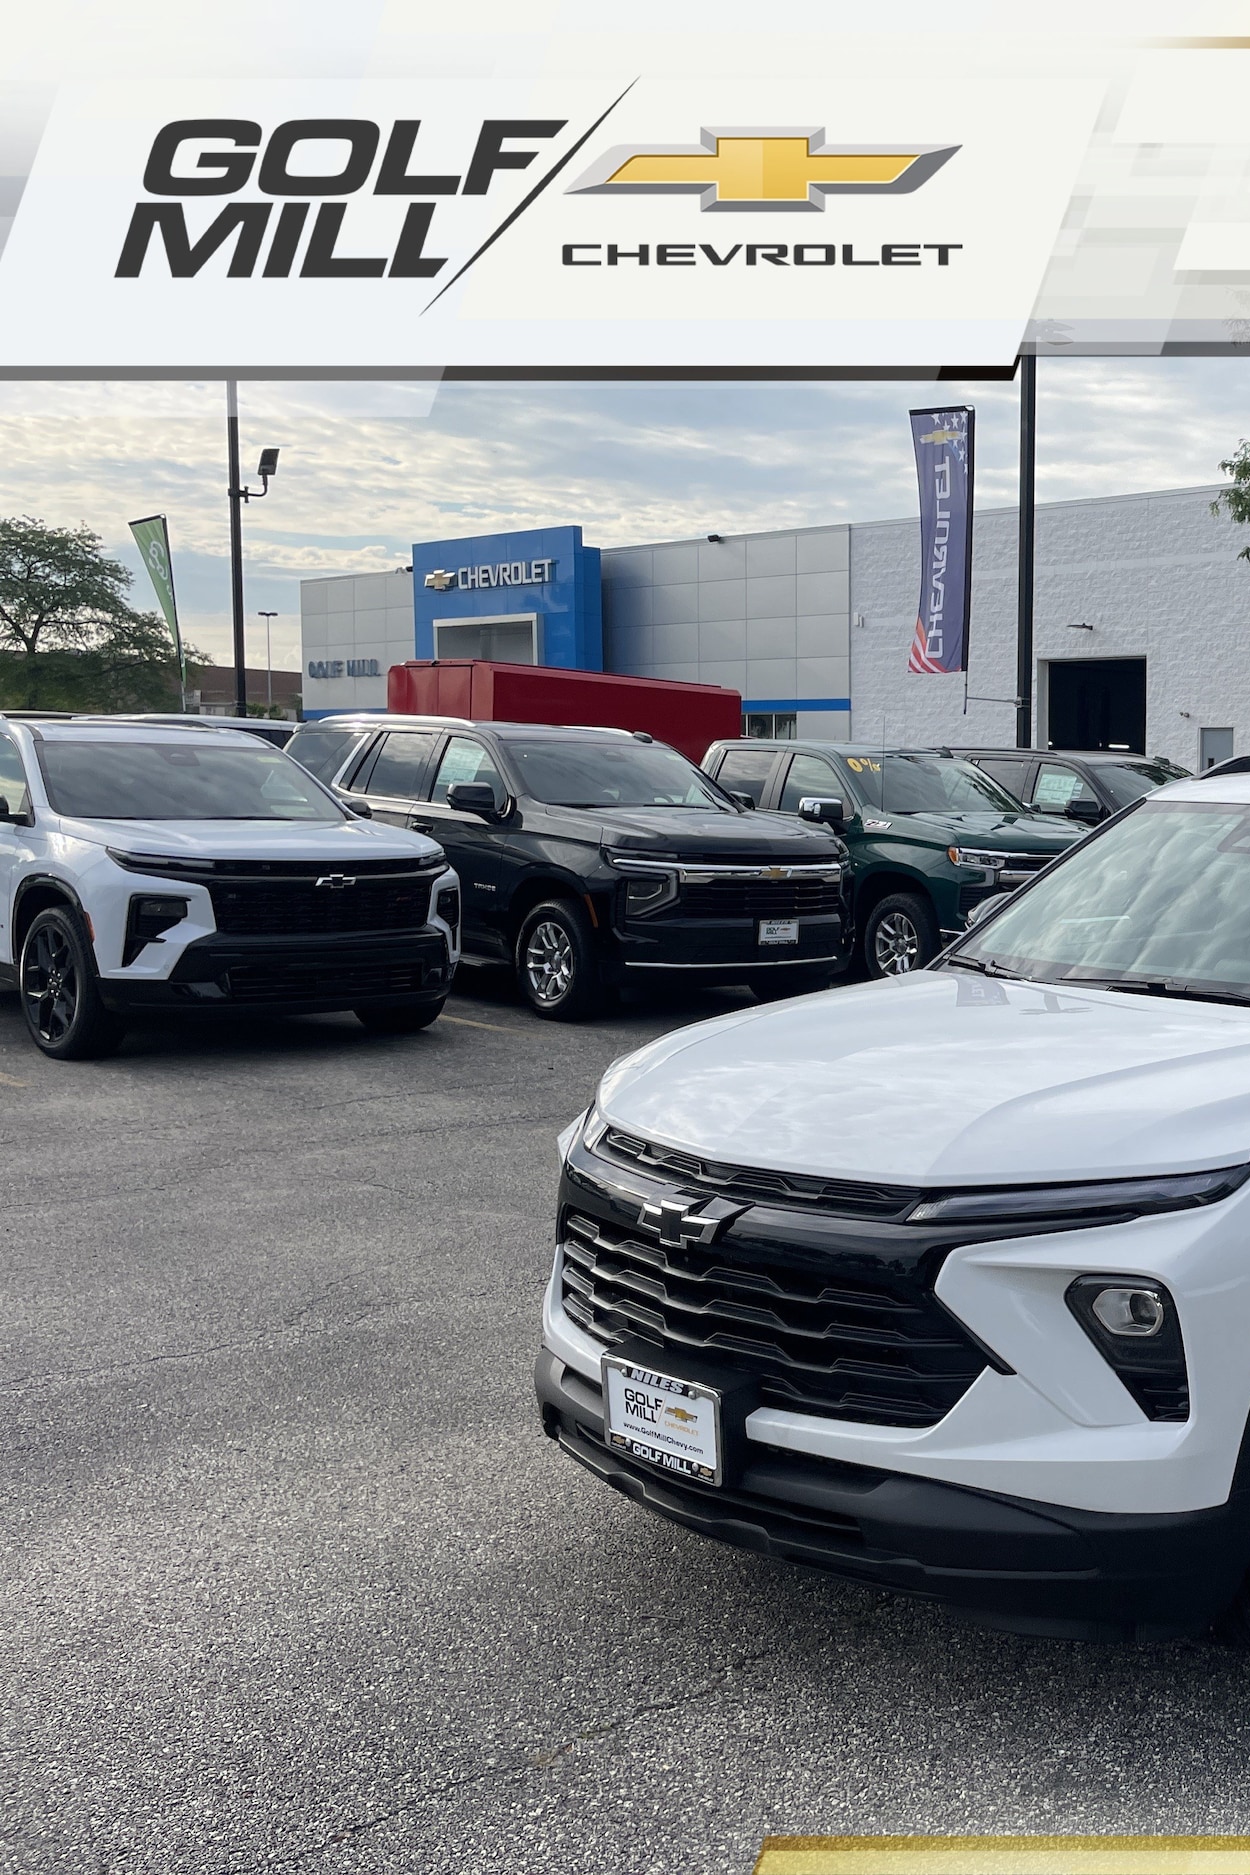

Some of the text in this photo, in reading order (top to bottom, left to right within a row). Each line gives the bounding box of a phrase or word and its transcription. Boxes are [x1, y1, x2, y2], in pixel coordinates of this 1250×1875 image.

[926, 455, 951, 659] CHEVROLET
[457, 559, 552, 590] CHEVROLET
[630, 1369, 684, 1394] NILES
[624, 1388, 663, 1411] GOLF
[625, 1401, 657, 1424] MILL
[632, 1442, 692, 1475] GOLF MILL
